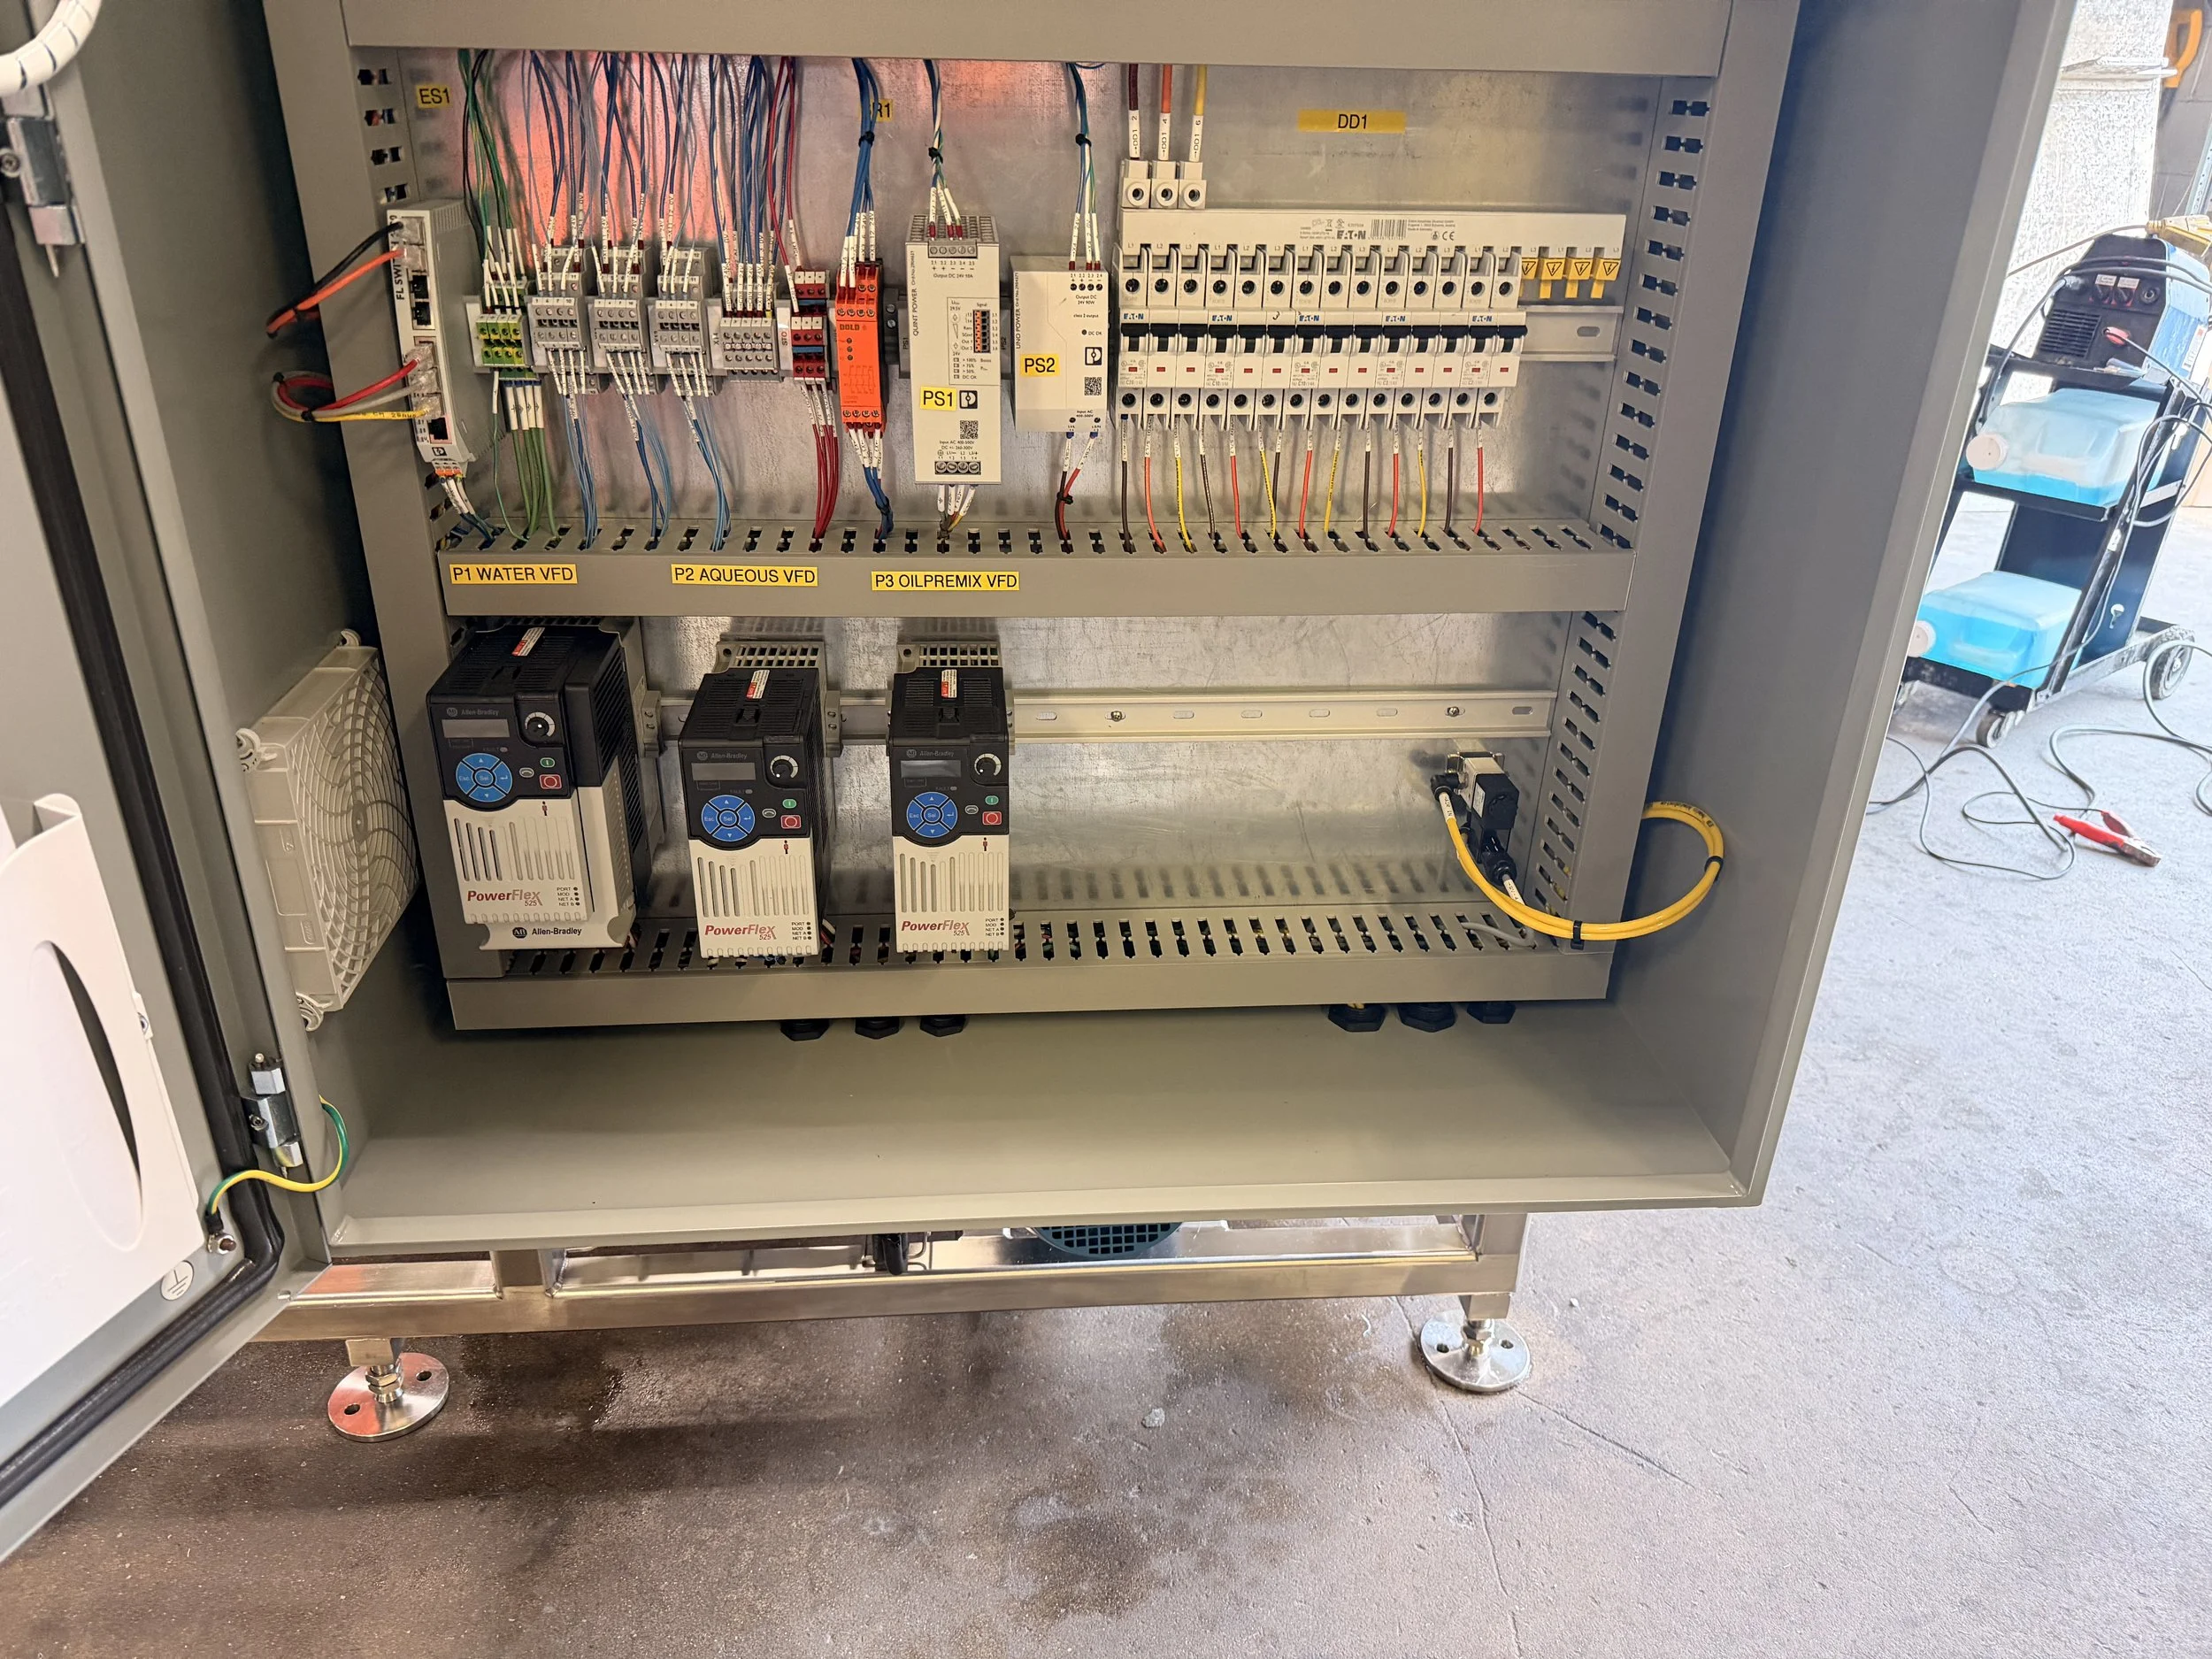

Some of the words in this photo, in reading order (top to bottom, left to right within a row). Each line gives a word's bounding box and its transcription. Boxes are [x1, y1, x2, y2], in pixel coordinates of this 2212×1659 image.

[419, 88, 449, 104] ES1
[869, 101, 890, 118] R1
[1338, 114, 1367, 129] DD1
[396, 288, 404, 300] FL
[1025, 357, 1056, 373] PS2
[924, 390, 952, 407] PS1
[452, 568, 471, 580] P1
[476, 568, 535, 580] WATER
[540, 568, 572, 580] VFD
[675, 568, 695, 580] P2
[699, 568, 779, 583] AQUEOUS
[783, 570, 815, 583] VFD
[876, 575, 895, 587] P3
[898, 575, 982, 588] OILPREMIX
[987, 575, 1017, 588] VFD
[467, 889, 542, 906] PowerFlex
[532, 927, 582, 936] Allen-Bradley
[704, 924, 777, 940] PowerFlex
[901, 920, 970, 935] PowerFlex
